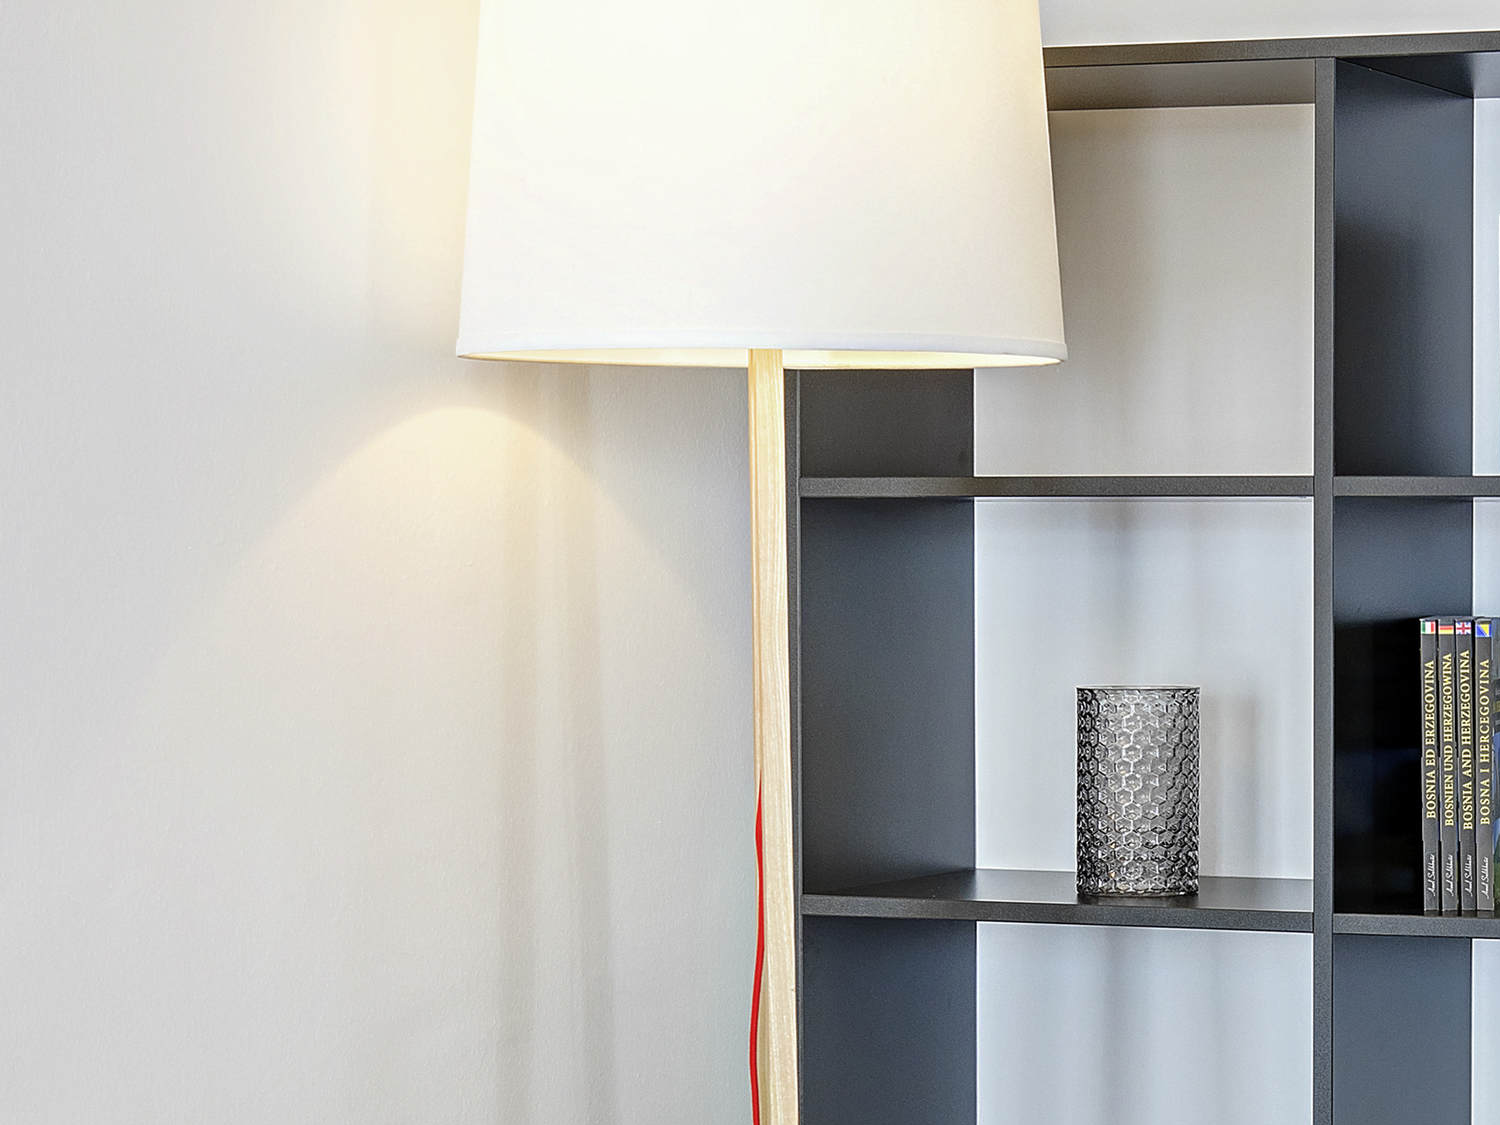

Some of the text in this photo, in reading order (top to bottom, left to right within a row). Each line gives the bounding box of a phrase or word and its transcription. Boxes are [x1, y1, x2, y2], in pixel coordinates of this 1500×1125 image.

[1424, 660, 1436, 819] BOSNIA ED ERZEGOVINA
[1442, 653, 1455, 826] BOSNIEN UND HERZEGOWINA
[1459, 650, 1473, 830] BOSNIA AND HERZEGOVINA
[1479, 659, 1491, 763] HERCEGOVINA
[1479, 779, 1491, 825] BOSNA
